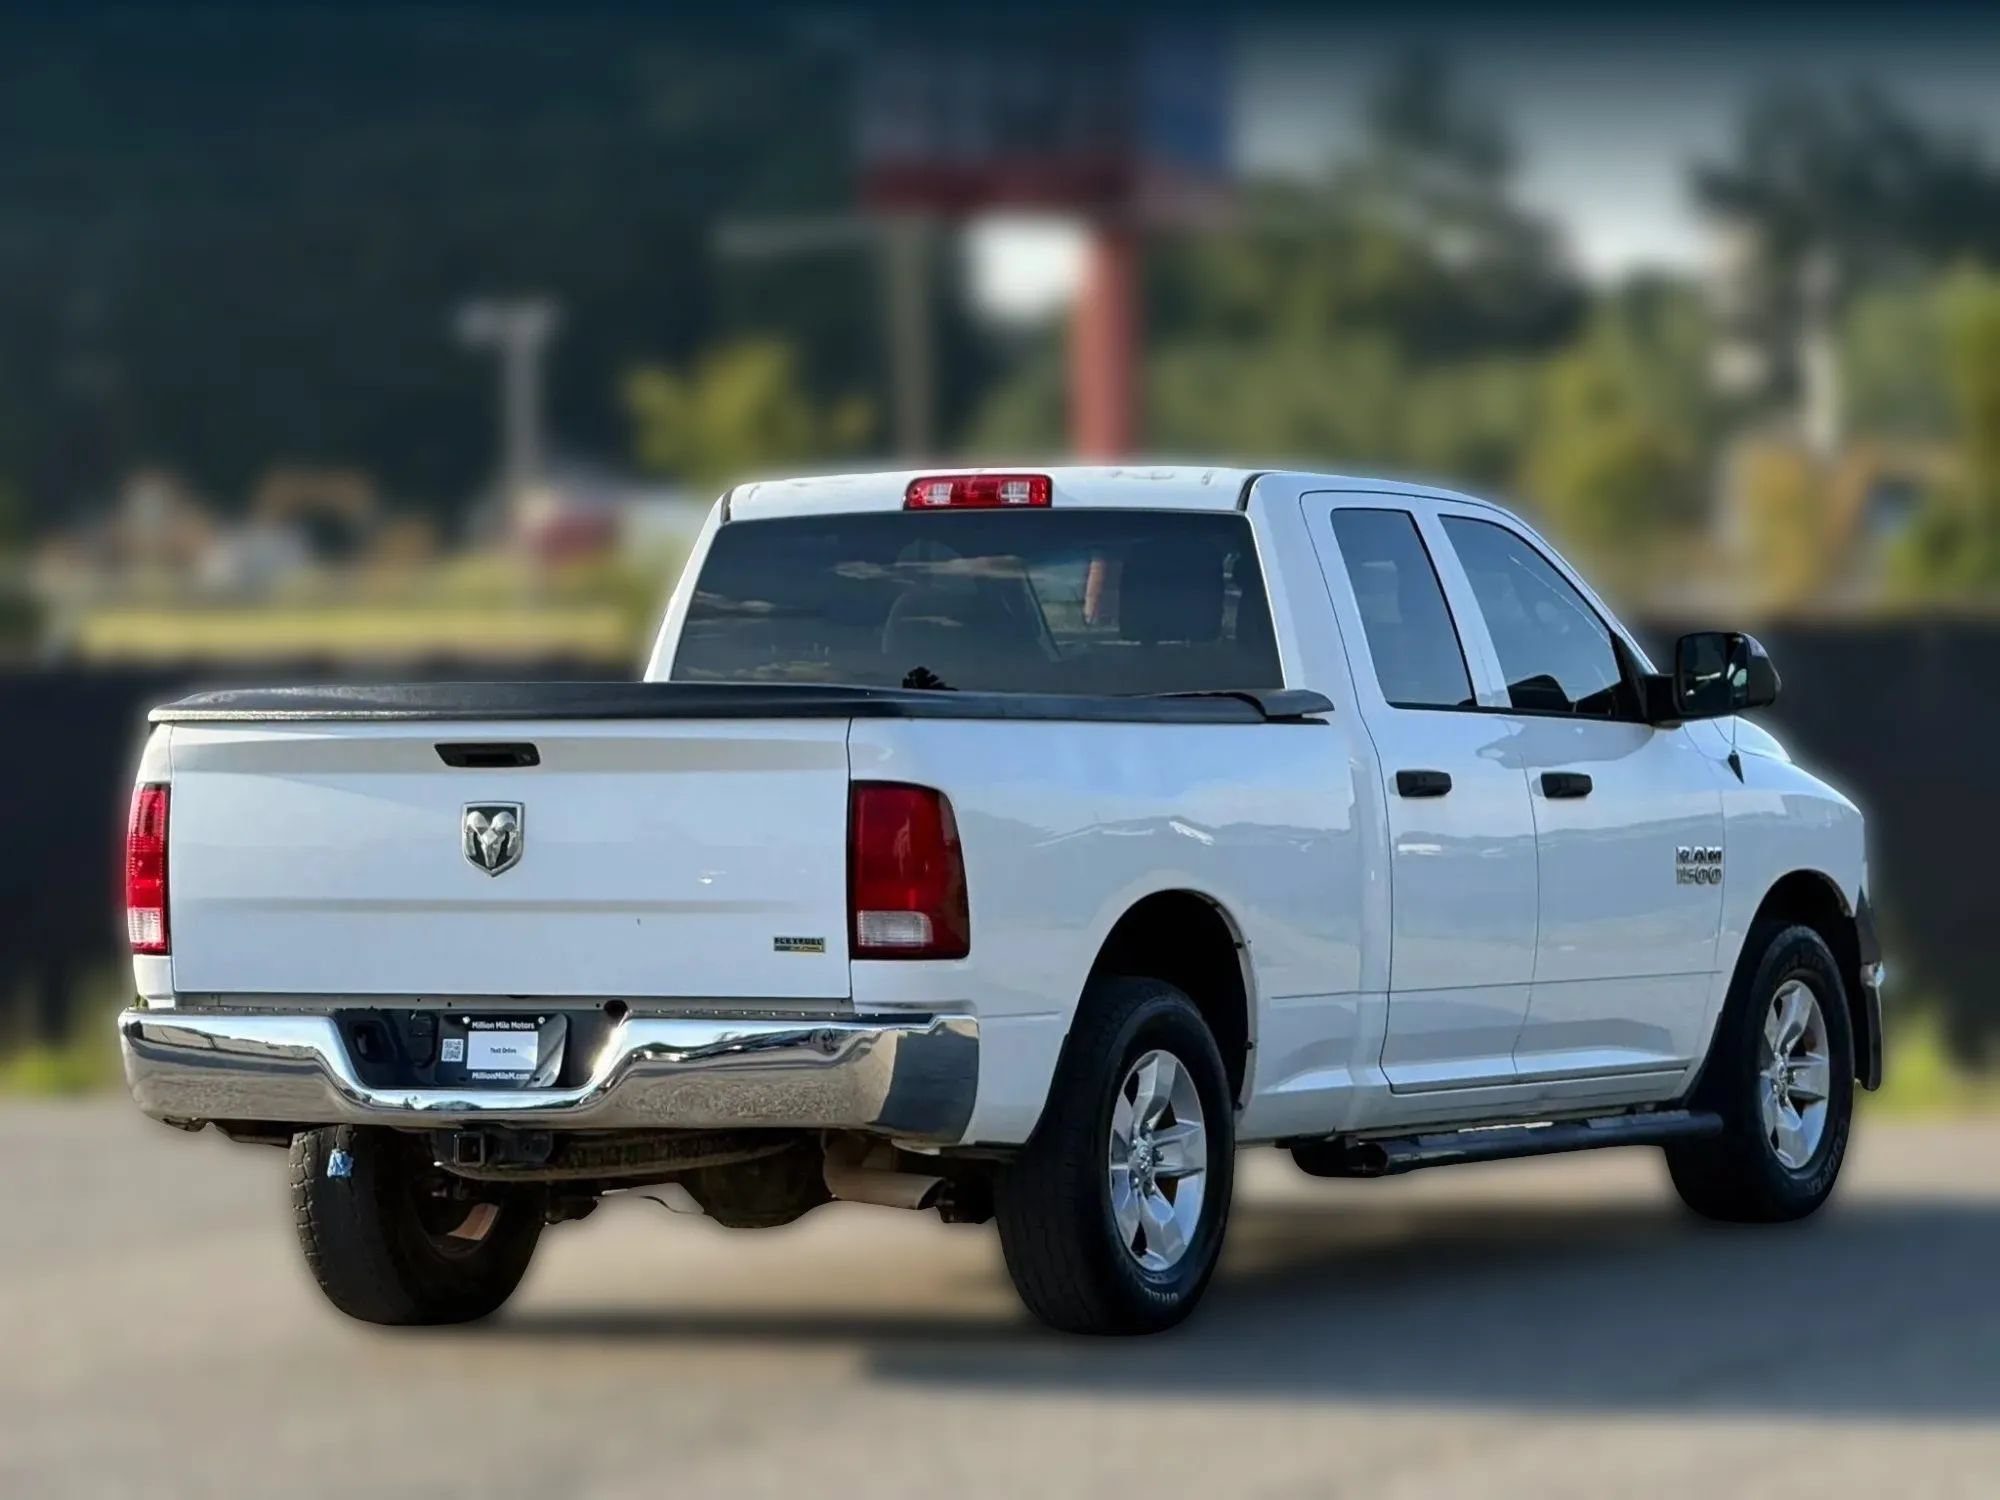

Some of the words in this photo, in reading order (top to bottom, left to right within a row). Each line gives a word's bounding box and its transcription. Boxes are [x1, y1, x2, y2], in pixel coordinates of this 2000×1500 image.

[1676, 846, 1722, 864] RAM
[1676, 865, 1722, 885] 1500
[472, 1021, 494, 1029] Million
[496, 1021, 510, 1029] Mile
[511, 1021, 534, 1029] Motors
[472, 1072, 530, 1080] MillionMileM.com
